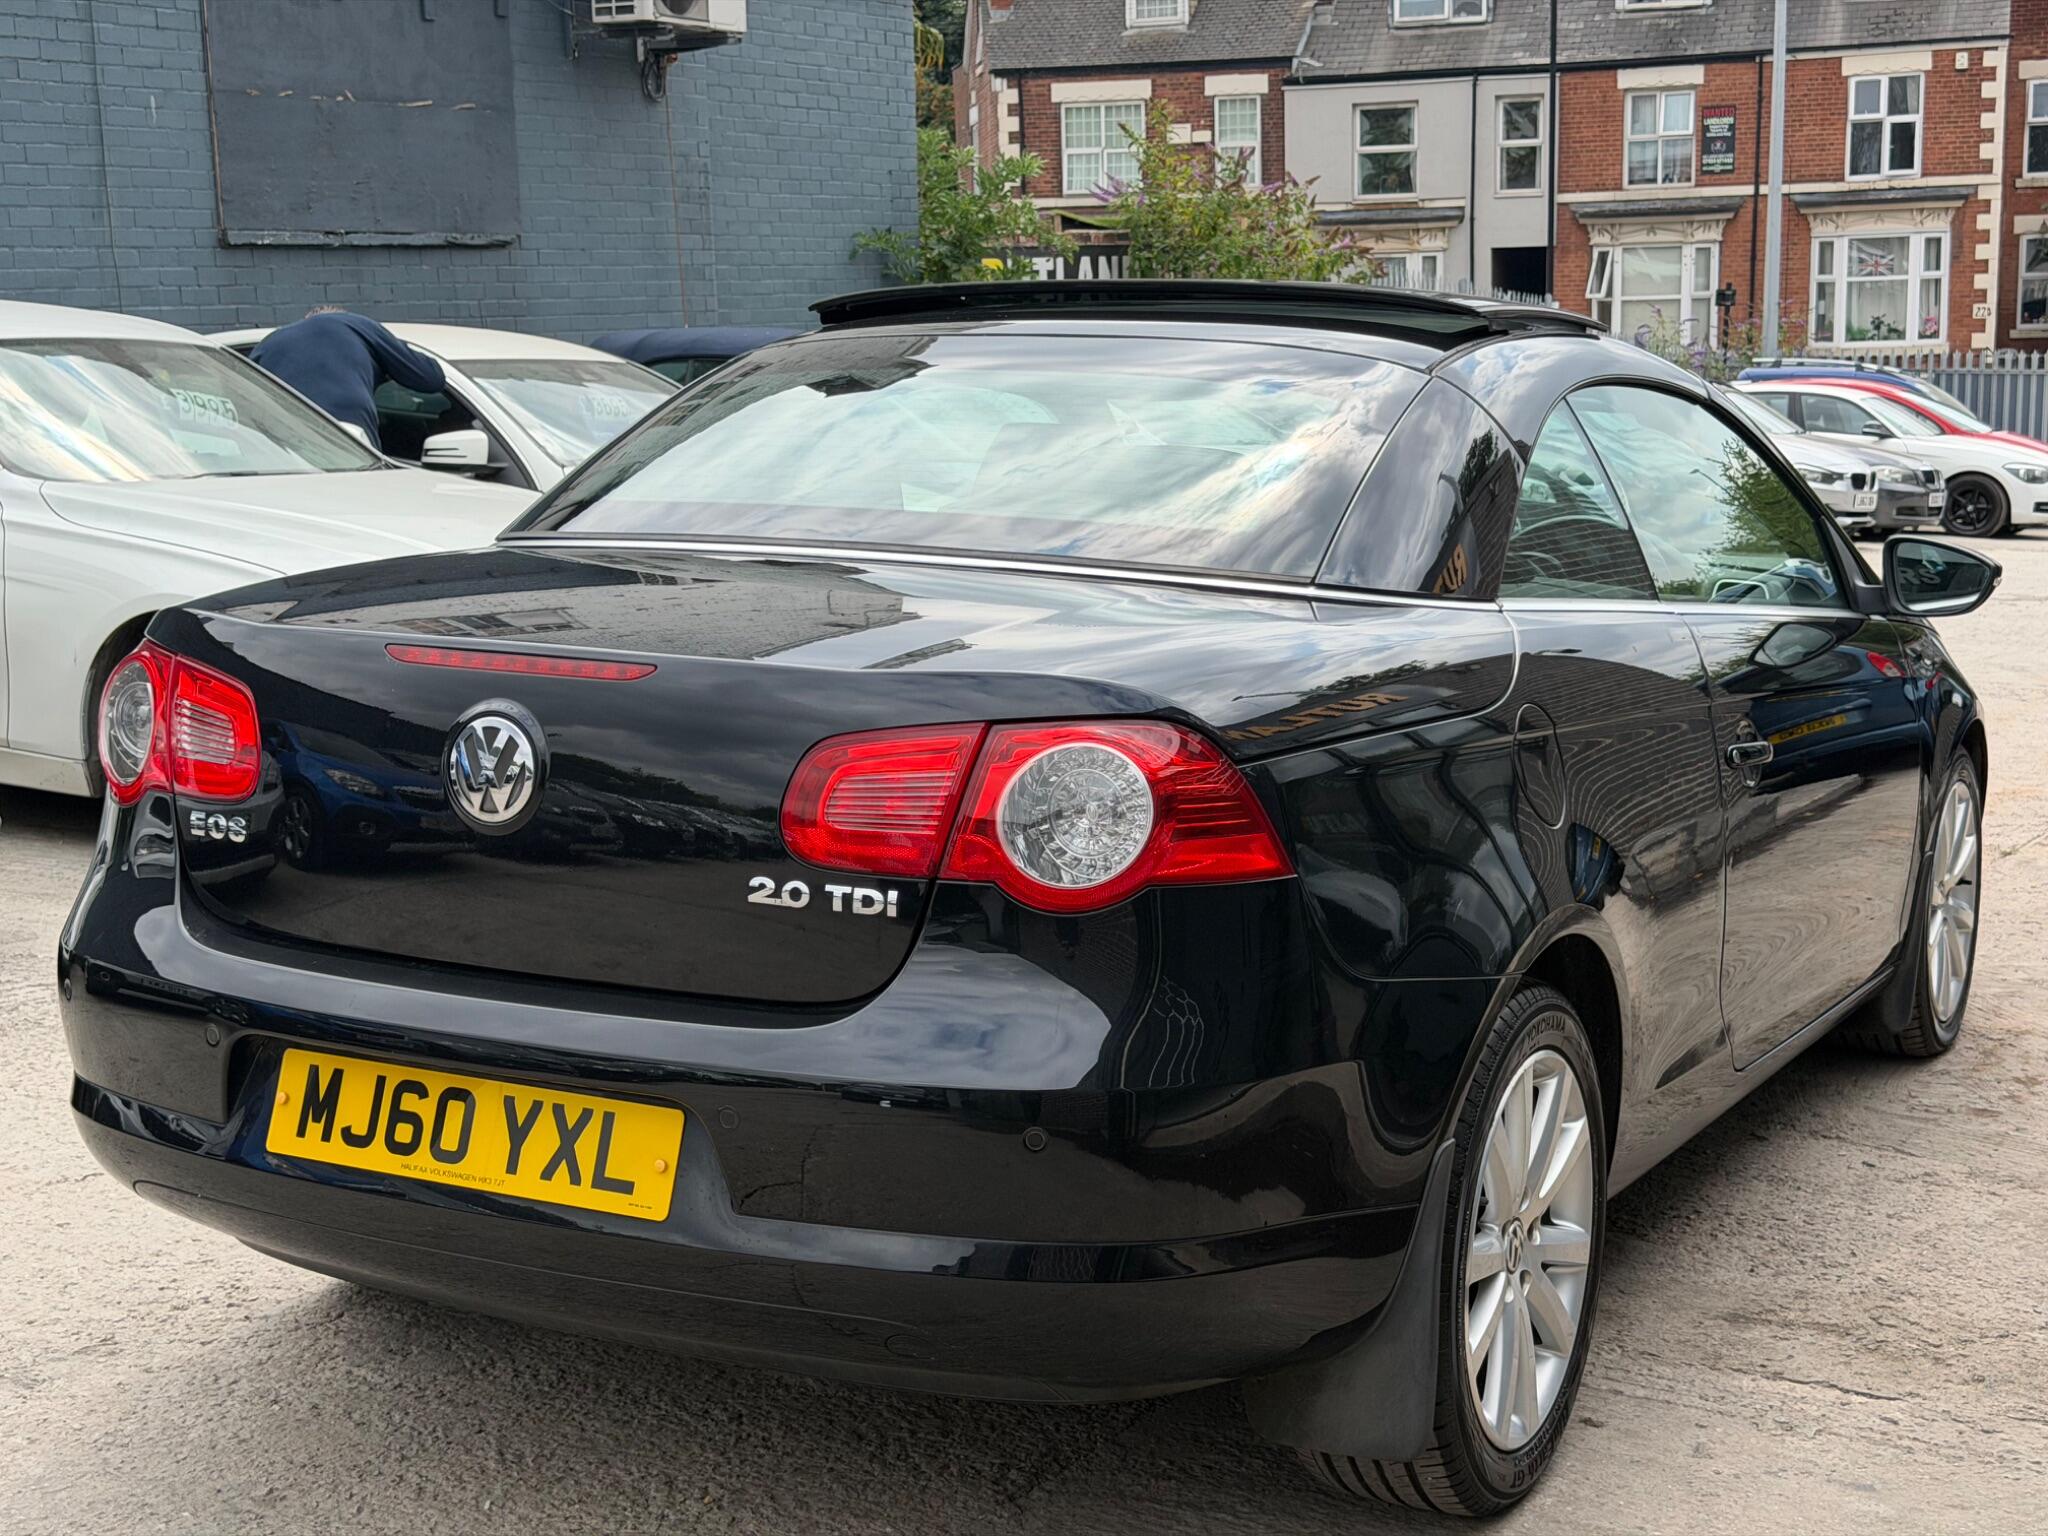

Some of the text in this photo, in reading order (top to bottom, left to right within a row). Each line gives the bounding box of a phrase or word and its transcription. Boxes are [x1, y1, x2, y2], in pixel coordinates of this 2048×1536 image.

[189, 810, 248, 843] EOS
[824, 884, 899, 918] TDI
[295, 1064, 636, 1196] MJ60 YXL
[427, 1167, 477, 1182] VOLKSWAGEN
